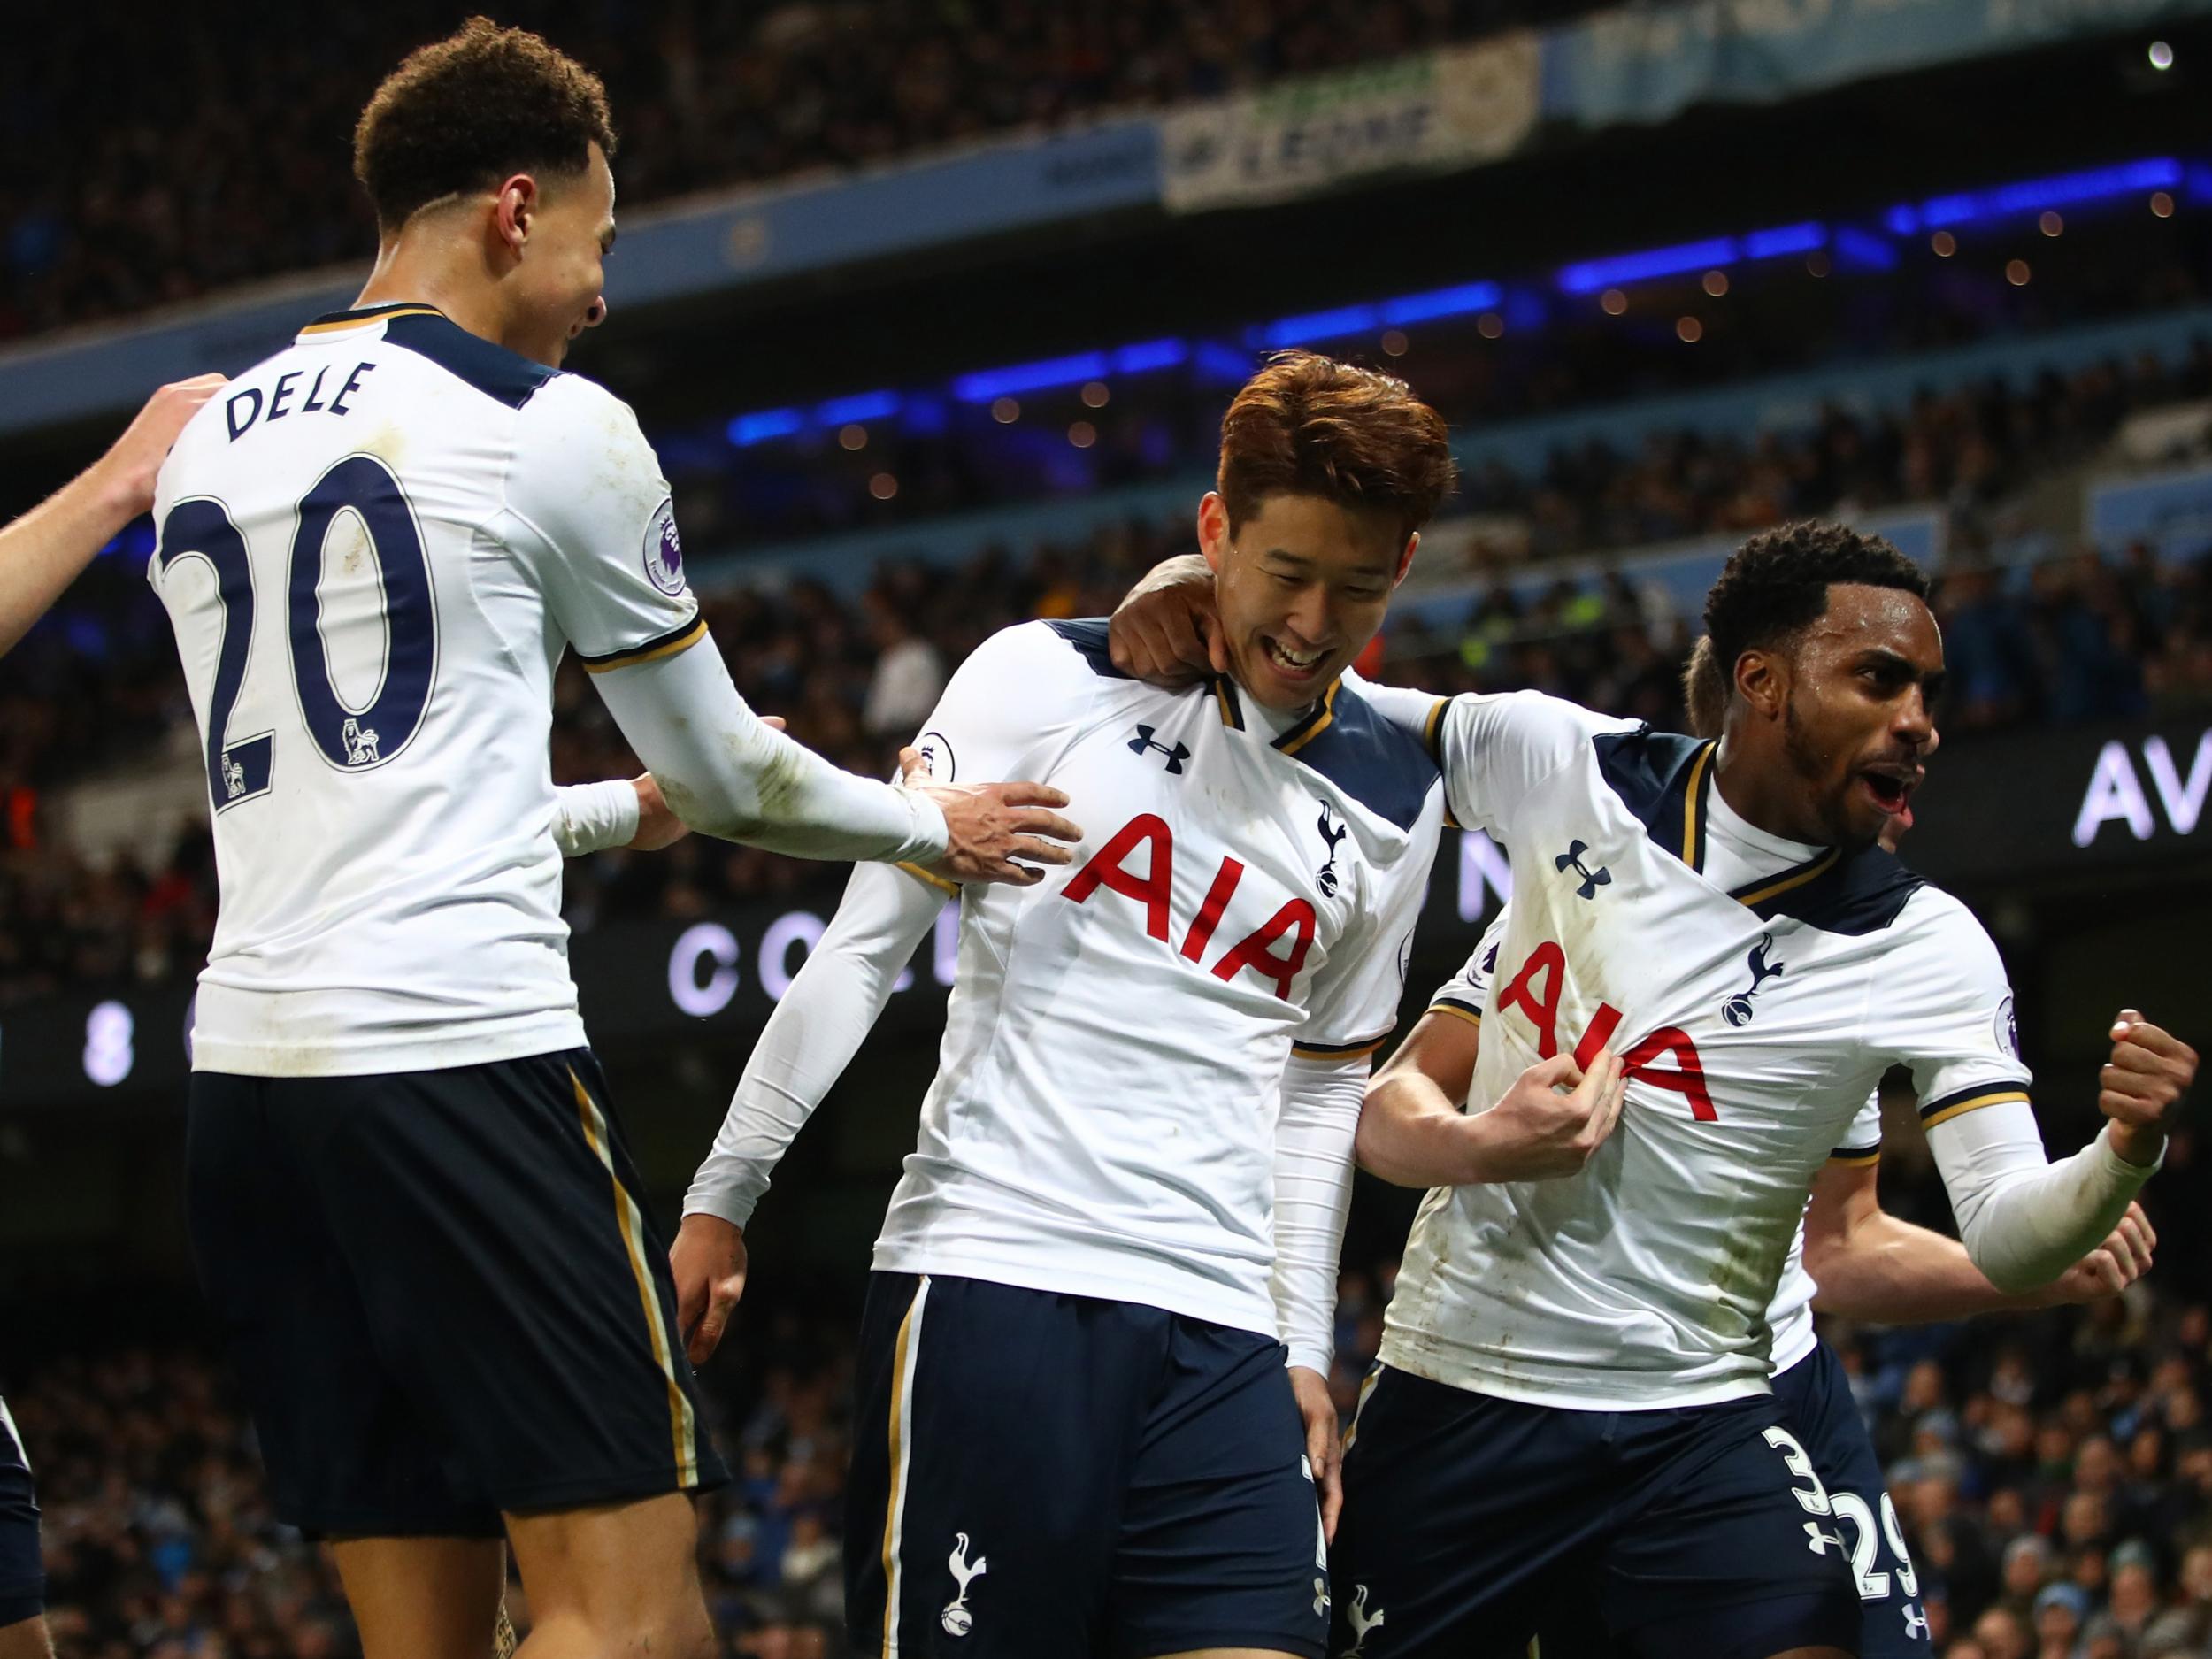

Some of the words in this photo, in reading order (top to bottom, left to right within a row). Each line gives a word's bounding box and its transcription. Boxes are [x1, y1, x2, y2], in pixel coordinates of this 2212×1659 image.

[227, 361, 378, 443] DELE
[158, 452, 440, 814] 20
[1061, 813, 1317, 1002] AIA
[1498, 941, 1718, 1122] AIA
[1761, 1425, 1831, 1517] 3
